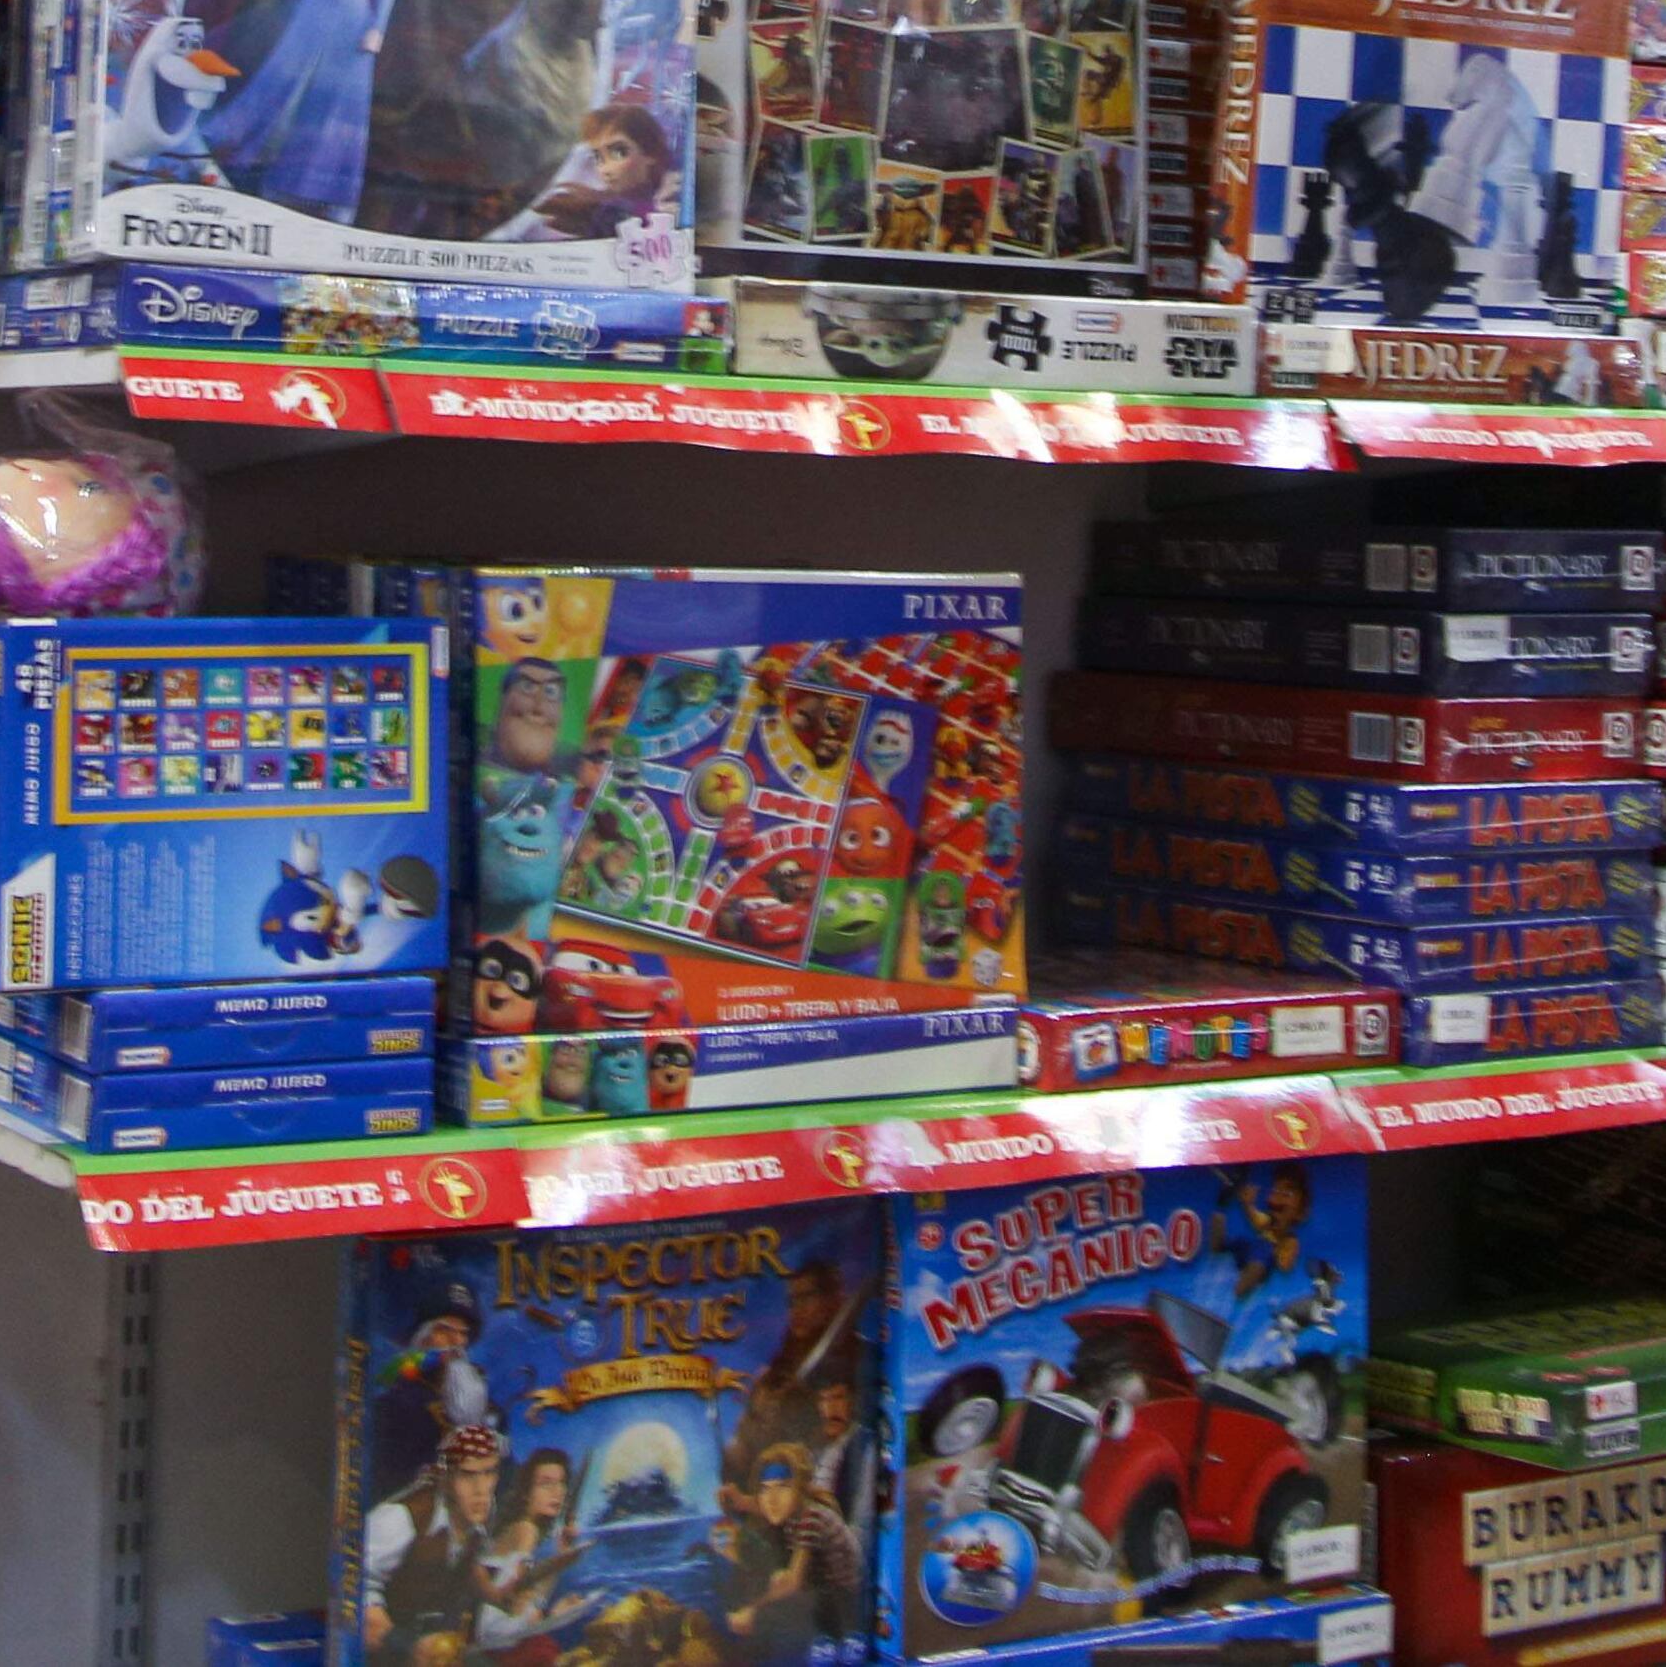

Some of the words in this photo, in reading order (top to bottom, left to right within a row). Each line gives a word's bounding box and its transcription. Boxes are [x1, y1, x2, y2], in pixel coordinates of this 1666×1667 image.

[122, 215, 245, 255] FROZEN
[247, 225, 272, 258] II
[342, 242, 422, 270] PUZZLE
[464, 253, 534, 275] PIEZAS
[628, 239, 672, 272] 500
[436, 314, 519, 339] PUZZLE
[1477, 553, 1607, 579] PICTIONARY
[903, 594, 1007, 621] PIXAR
[1469, 797, 1515, 847] LA
[1519, 792, 1613, 844] PISTA
[1470, 864, 1515, 916] LA
[1519, 859, 1606, 912] PISTA
[10, 894, 34, 985] SONIC
[1473, 930, 1515, 982] LA
[1519, 925, 1609, 977] PISTA
[924, 1011, 1004, 1036] PIXAR
[1486, 1001, 1528, 1052] LA
[1532, 994, 1621, 1048] PISTA
[1381, 1107, 1413, 1128] EL
[1414, 1098, 1503, 1124] MUNDO
[1504, 1093, 1552, 1117] DEL
[1556, 1082, 1666, 1113] JUGUETE
[944, 1136, 1054, 1164] MUNDO
[638, 1157, 784, 1193] JUGUETE
[142, 1189, 214, 1223] DEL
[220, 1181, 385, 1217] JUGUETE
[954, 1172, 1143, 1272] SUPER
[494, 1227, 791, 1307] INSPECTOR
[610, 1293, 746, 1357] TRUE
[1489, 1549, 1659, 1620] RUMMY
